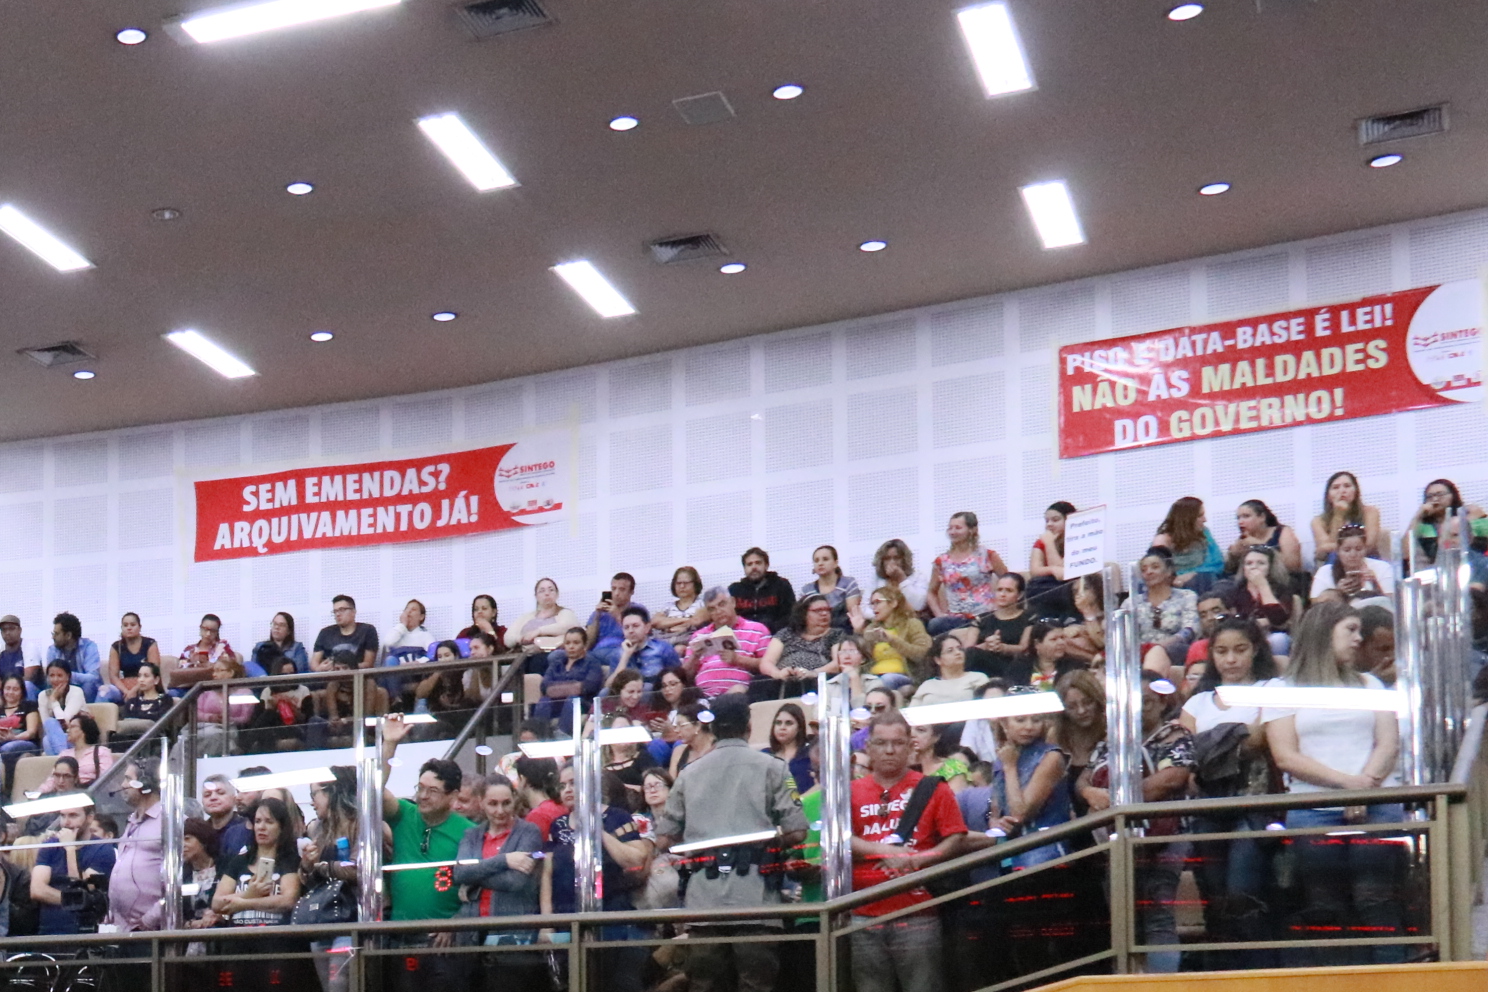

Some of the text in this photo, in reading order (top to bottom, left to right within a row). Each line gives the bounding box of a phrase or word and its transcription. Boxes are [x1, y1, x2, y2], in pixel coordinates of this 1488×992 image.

[1159, 316, 1306, 362] DATA-BASE
[1314, 308, 1332, 338] É
[1340, 302, 1394, 334] LEI!
[1071, 376, 1138, 413] NÃO
[1201, 338, 1389, 394] MALDADES
[1113, 387, 1345, 447] DO GOVERNO!
[242, 463, 451, 512] SEM EMENDAS?
[519, 460, 555, 474] SINTEGO
[213, 490, 479, 554] ARQUIVAMENTO JÁ!
